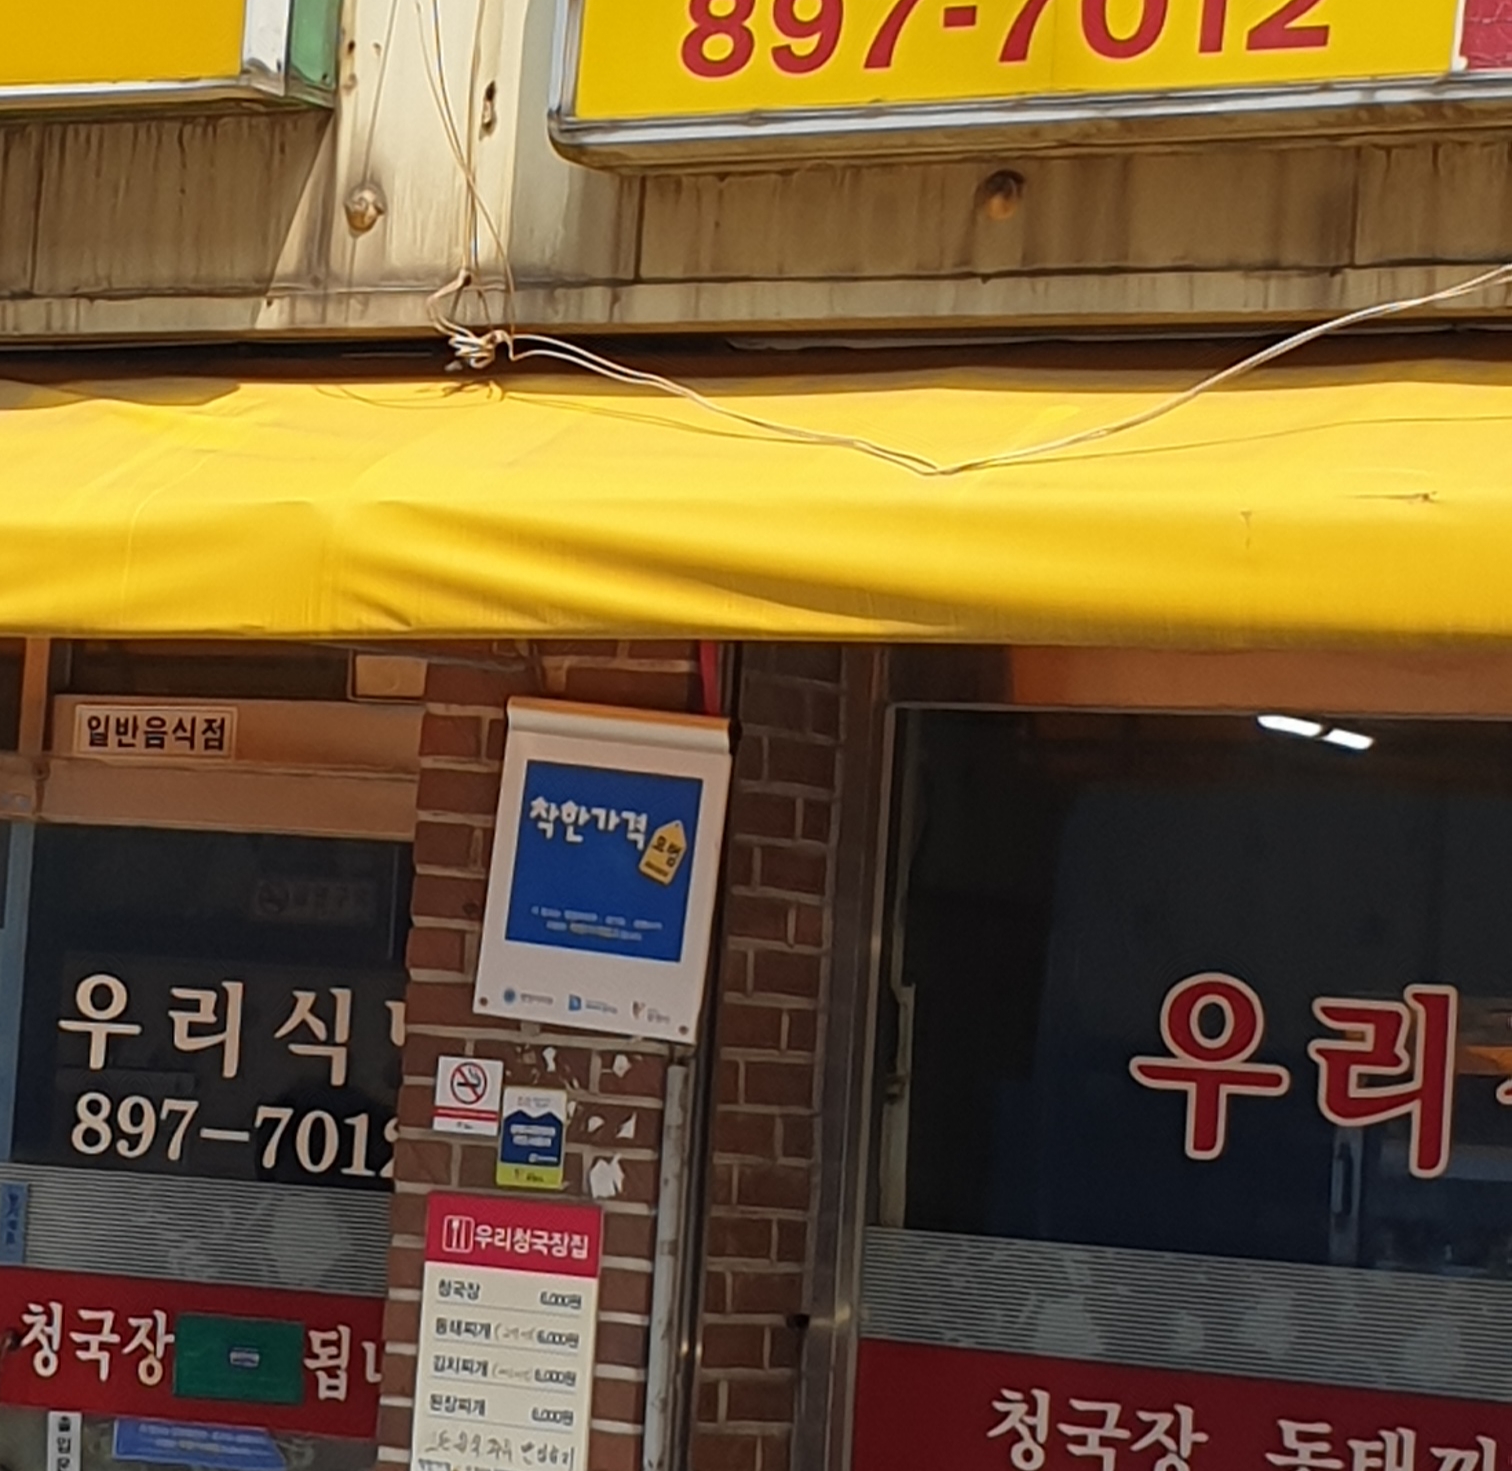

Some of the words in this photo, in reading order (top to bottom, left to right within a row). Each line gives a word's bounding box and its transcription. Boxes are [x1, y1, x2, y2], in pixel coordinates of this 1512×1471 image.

[86, 714, 227, 753] 일반음식점
[475, 1224, 589, 1260] 우리청국장집
[21, 1301, 175, 1387] 청국장
